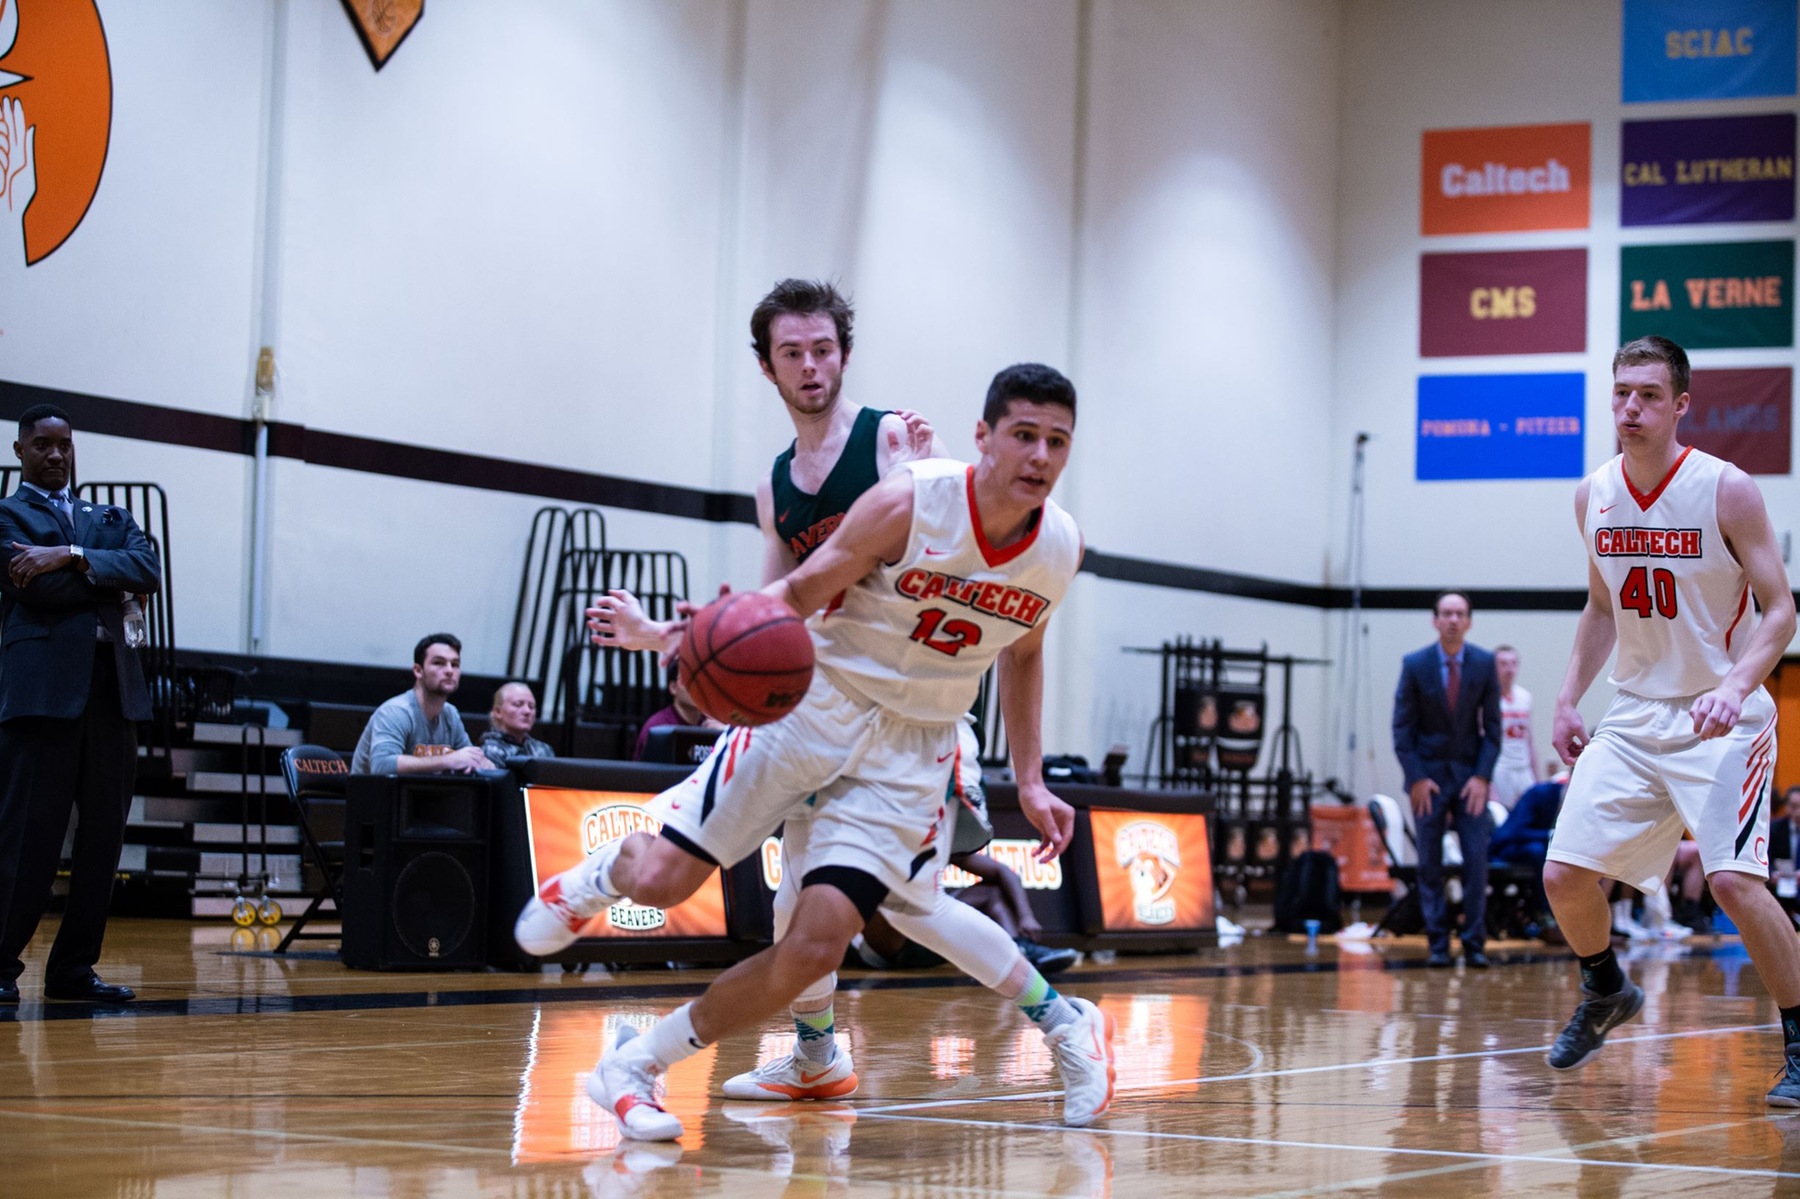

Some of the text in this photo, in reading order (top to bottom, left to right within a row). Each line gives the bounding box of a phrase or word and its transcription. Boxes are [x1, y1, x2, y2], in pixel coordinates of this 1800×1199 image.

[1665, 28, 1754, 59] SCIAC
[1440, 159, 1571, 198] Caltech
[1624, 157, 1793, 187] CAL LUTHERAN
[1470, 286, 1536, 320] CMS
[1631, 276, 1782, 312] LA VERNE
[1596, 527, 1702, 558] CALTECH
[896, 568, 1050, 627] CALTECH
[1620, 566, 1678, 620] 40
[910, 607, 982, 656] 12
[293, 758, 349, 775] CALTECH
[586, 810, 662, 849] CALTEC
[610, 906, 664, 927] BEAVERS
